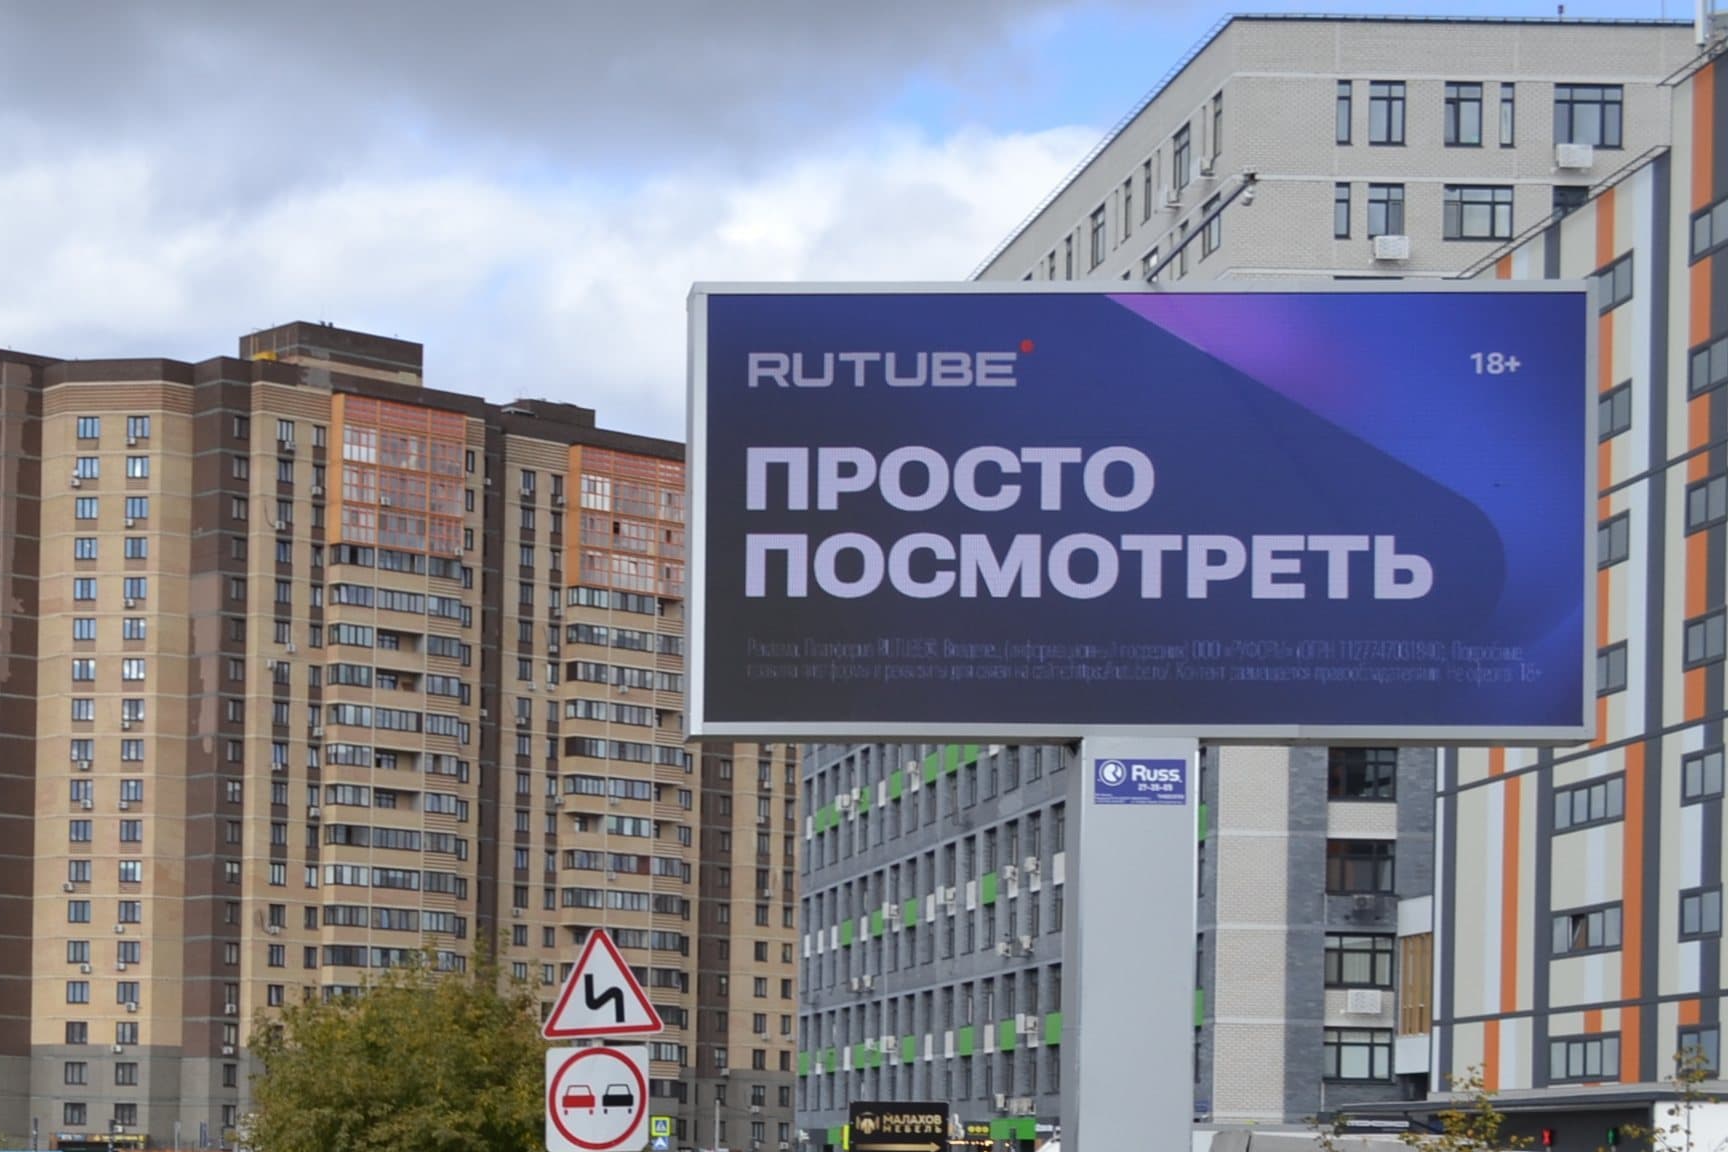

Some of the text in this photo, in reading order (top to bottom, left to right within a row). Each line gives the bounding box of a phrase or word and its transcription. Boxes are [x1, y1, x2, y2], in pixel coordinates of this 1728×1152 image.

[748, 352, 1017, 388] RUTUBE
[1470, 352, 1521, 375] 18+
[746, 445, 1155, 512] ПРОСТО
[745, 532, 1434, 599] ПОСМОТРЕТЬ
[1132, 764, 1181, 782] Russ
[882, 1113, 943, 1125] МАЛАХОВ
